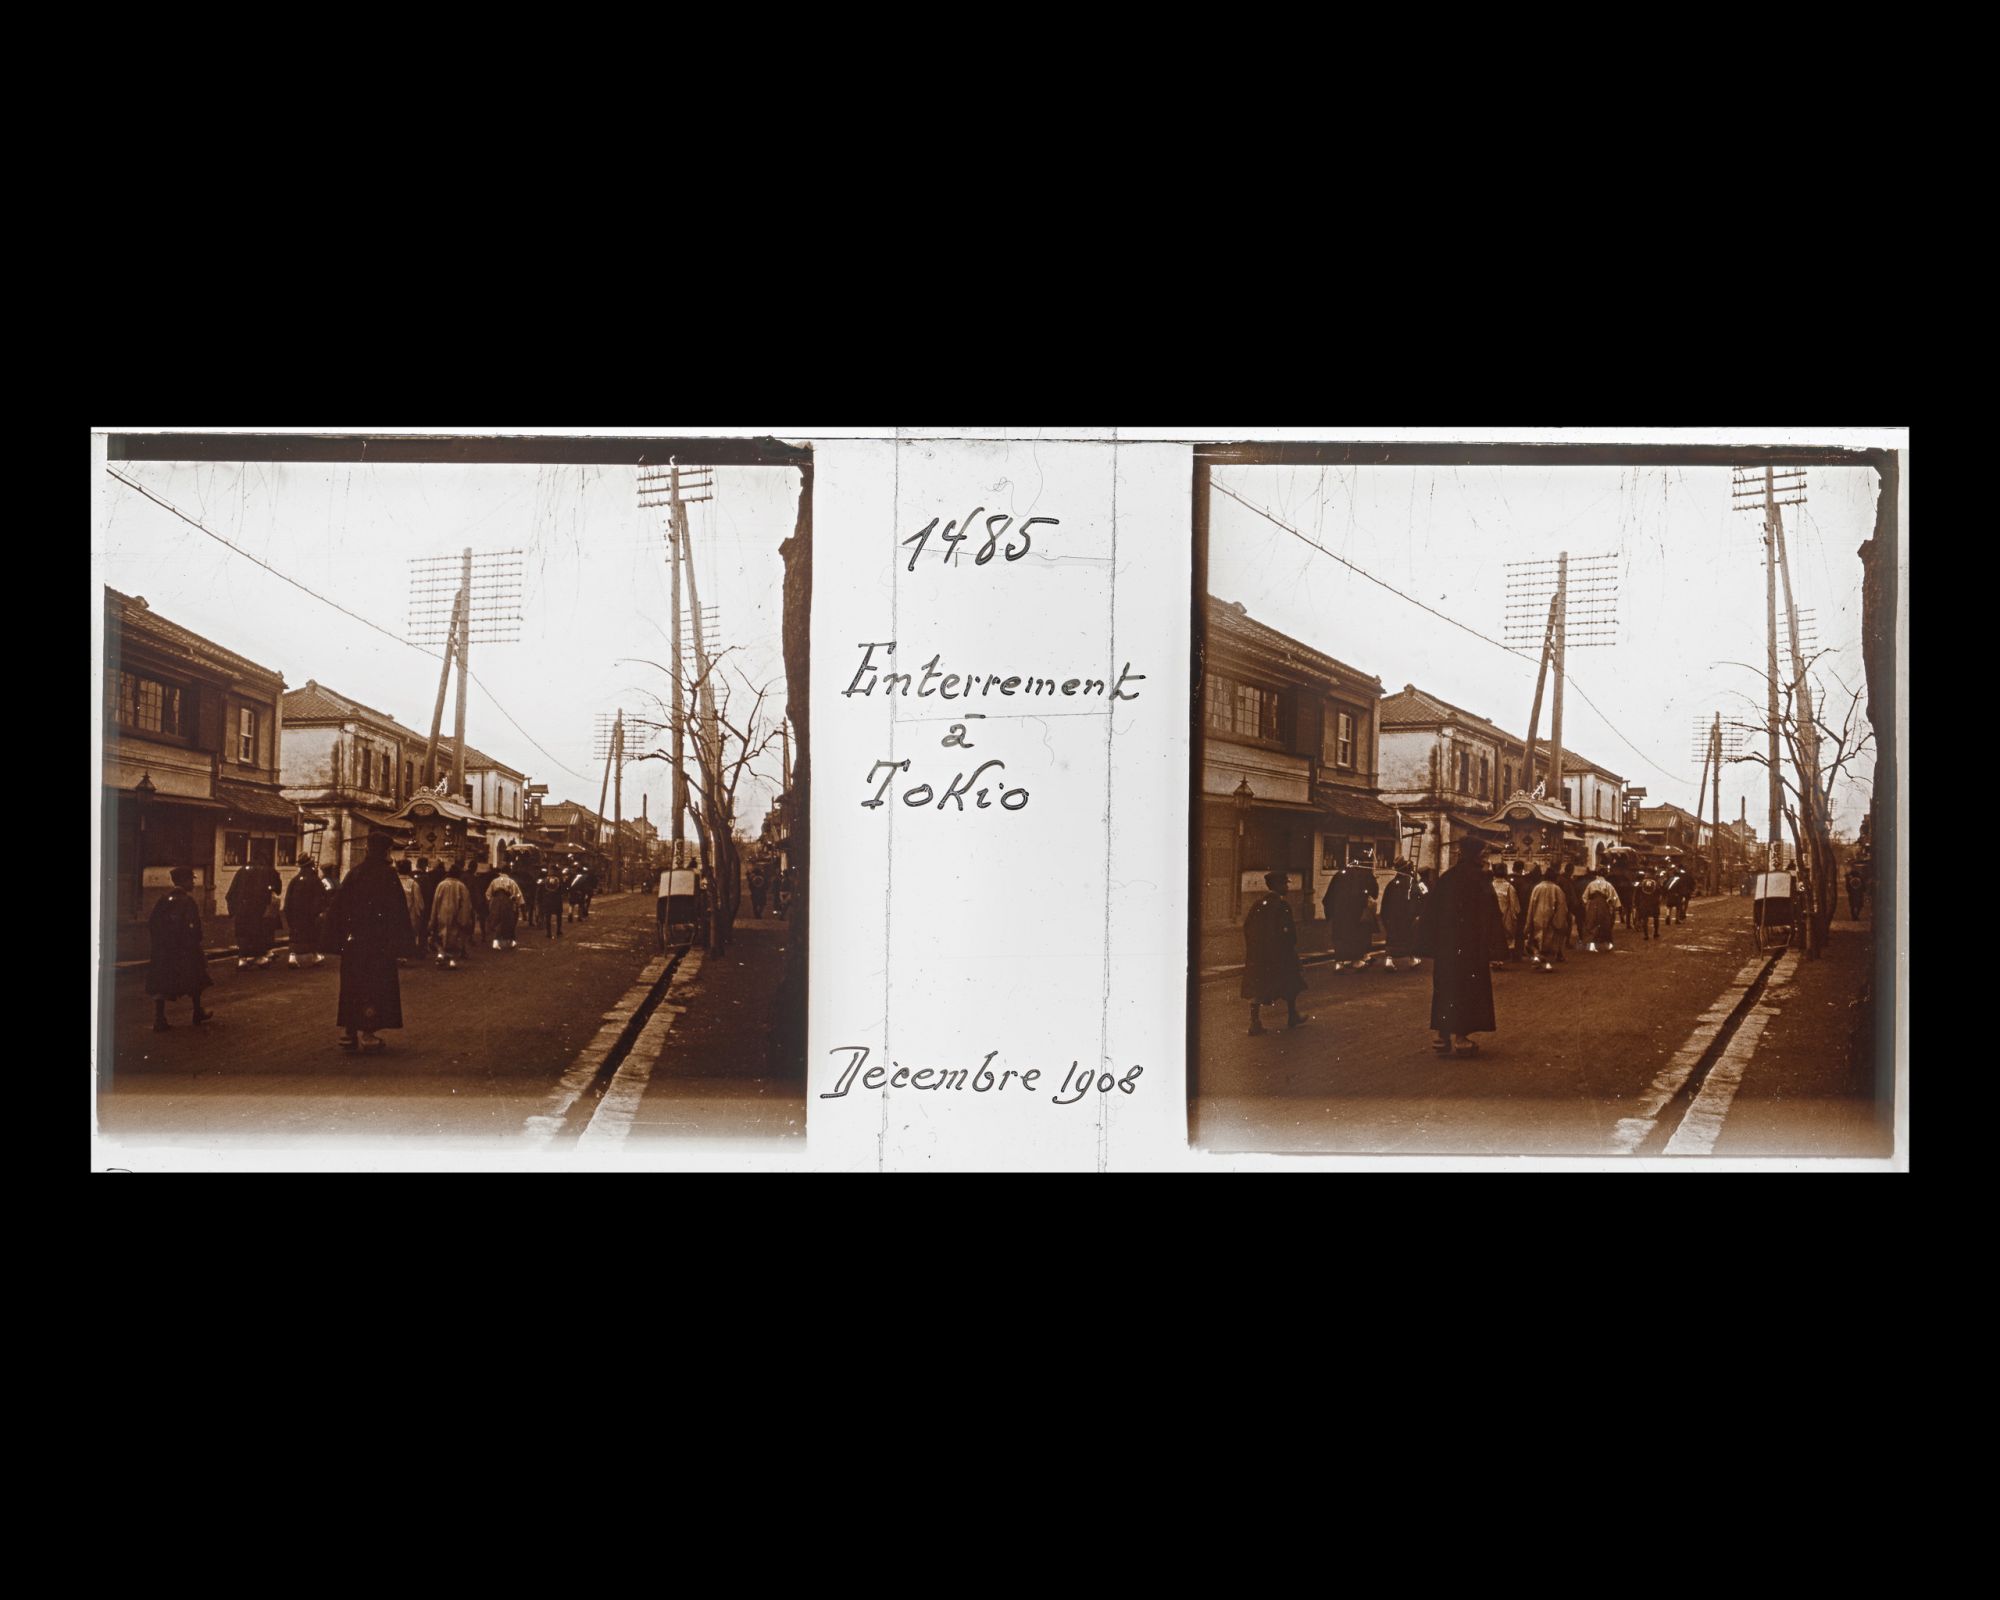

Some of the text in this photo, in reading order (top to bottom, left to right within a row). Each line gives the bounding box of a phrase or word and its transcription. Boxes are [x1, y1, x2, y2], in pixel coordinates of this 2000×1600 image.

[901, 506, 1060, 572] 1485
[841, 641, 1147, 701] Enterrement
[1051, 1059, 1145, 1105] 1908
